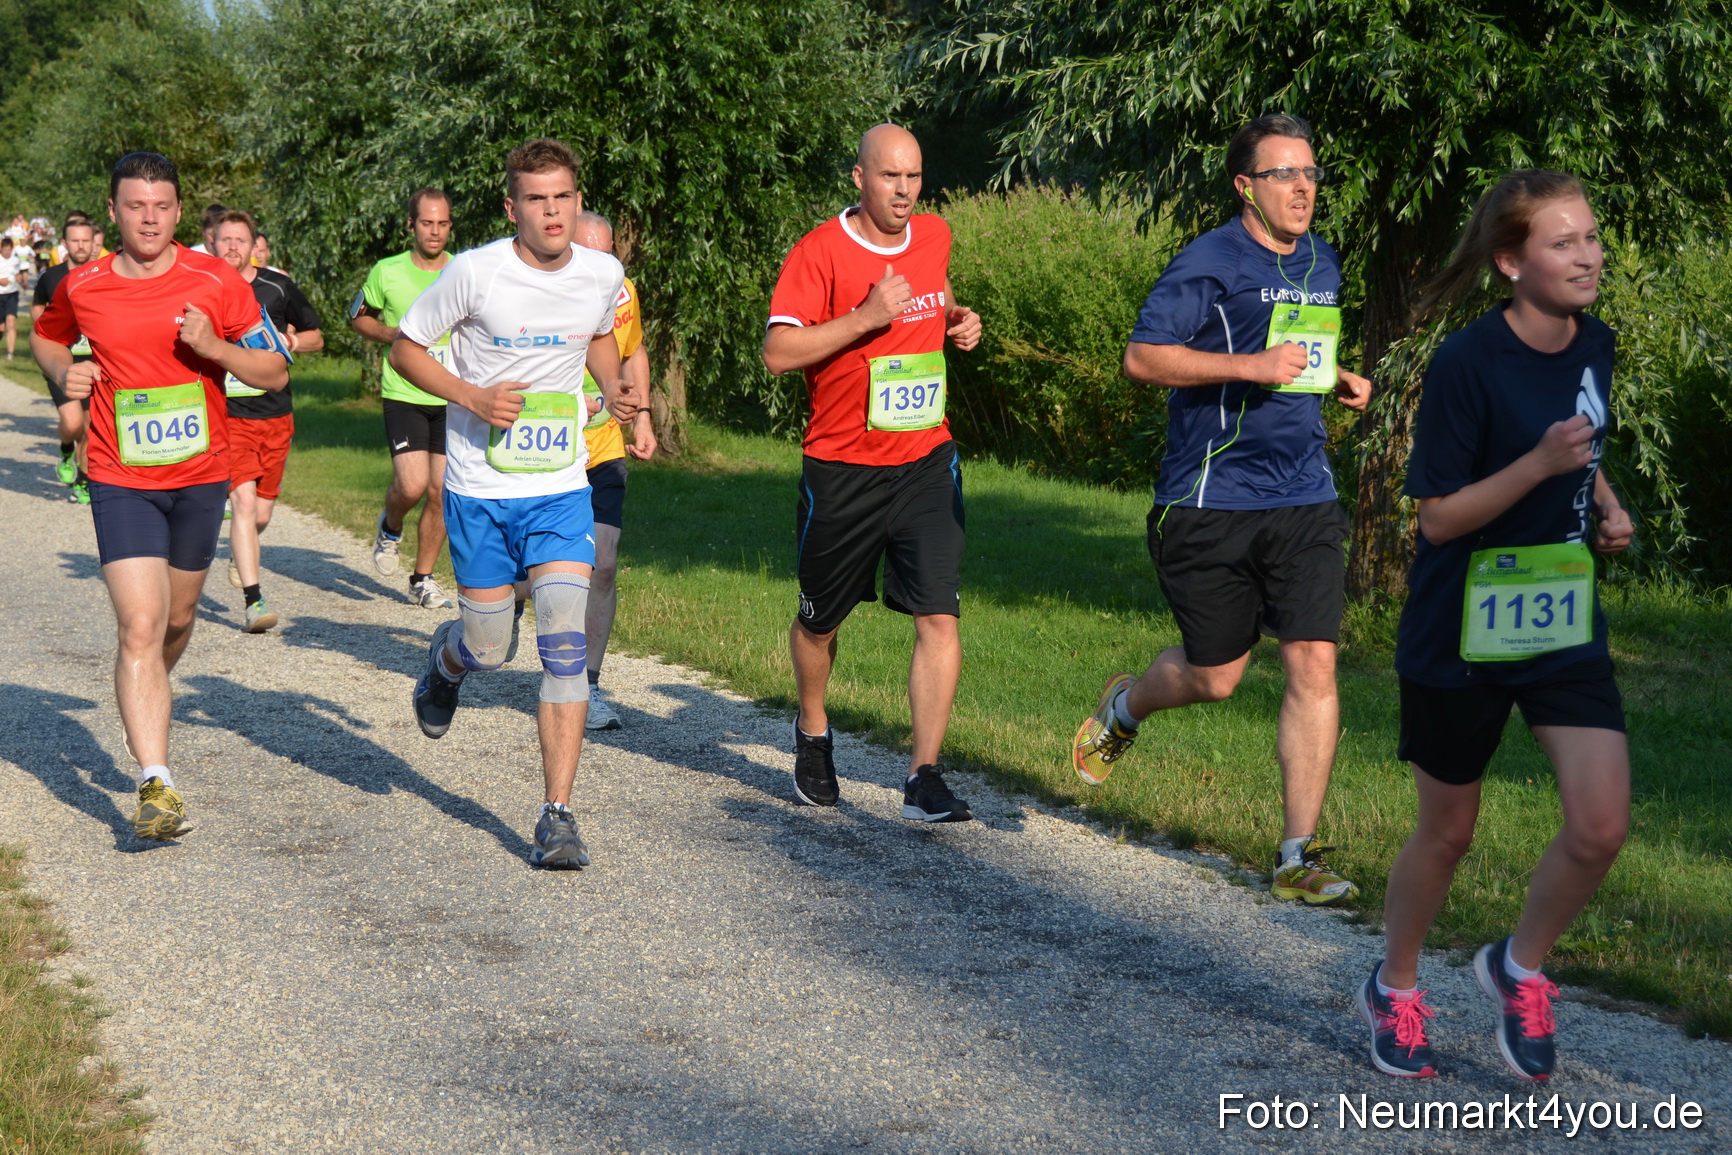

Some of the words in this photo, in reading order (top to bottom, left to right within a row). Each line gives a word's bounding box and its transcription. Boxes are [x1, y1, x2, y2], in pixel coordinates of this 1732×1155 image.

[902, 314, 923, 324] STARKE
[879, 383, 940, 411] 1397
[127, 414, 200, 445] 1046
[500, 425, 569, 452] 1304
[1487, 564, 1533, 576] firmenlauf
[1479, 589, 1575, 630] 1131
[1500, 637, 1532, 645] Theresa
[1532, 636, 1556, 644] Sturm
